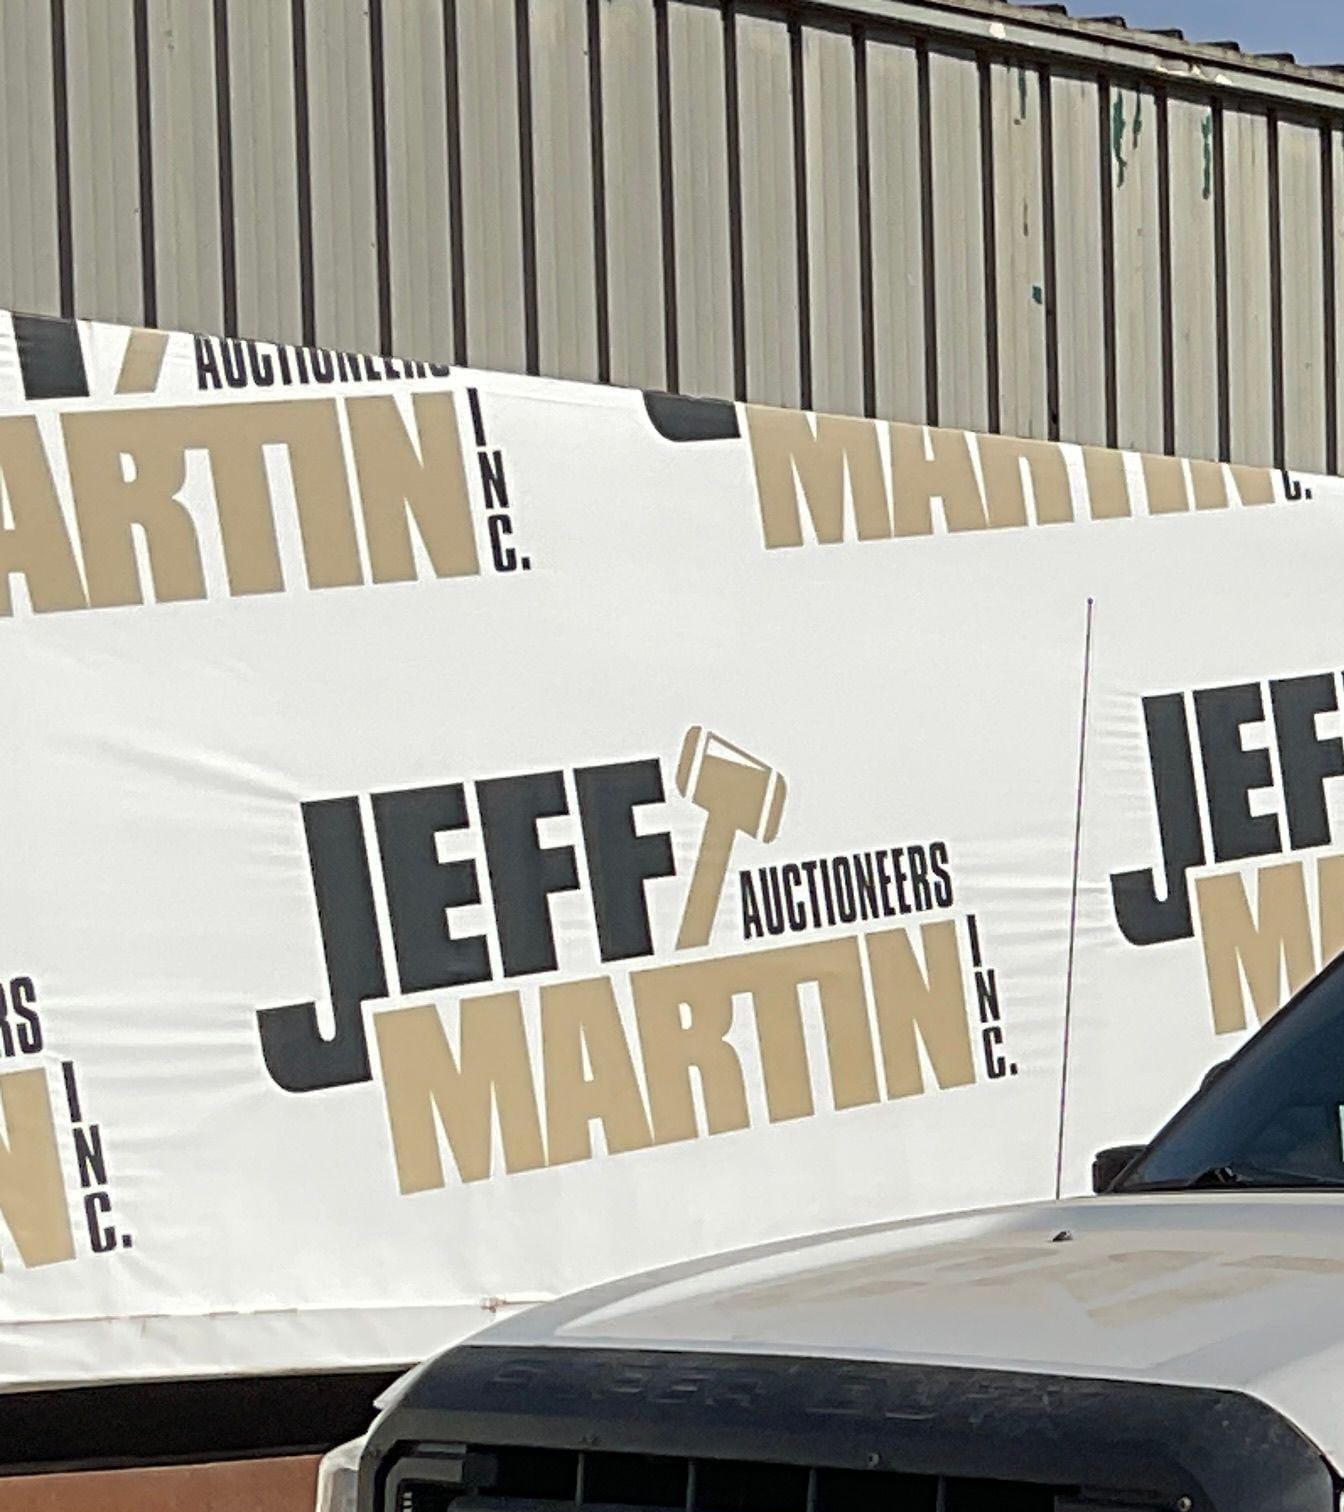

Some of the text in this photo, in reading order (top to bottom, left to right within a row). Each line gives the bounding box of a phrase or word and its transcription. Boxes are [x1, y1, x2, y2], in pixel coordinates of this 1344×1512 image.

[0, 390, 480, 617] ARTIN
[466, 386, 531, 573] INC.
[256, 757, 677, 1093] JEFF
[739, 841, 954, 940] AUCTIONEERS
[374, 918, 978, 1196] MARTIN
[965, 913, 1019, 1080] INC.
[61, 1060, 133, 1254] INC.
